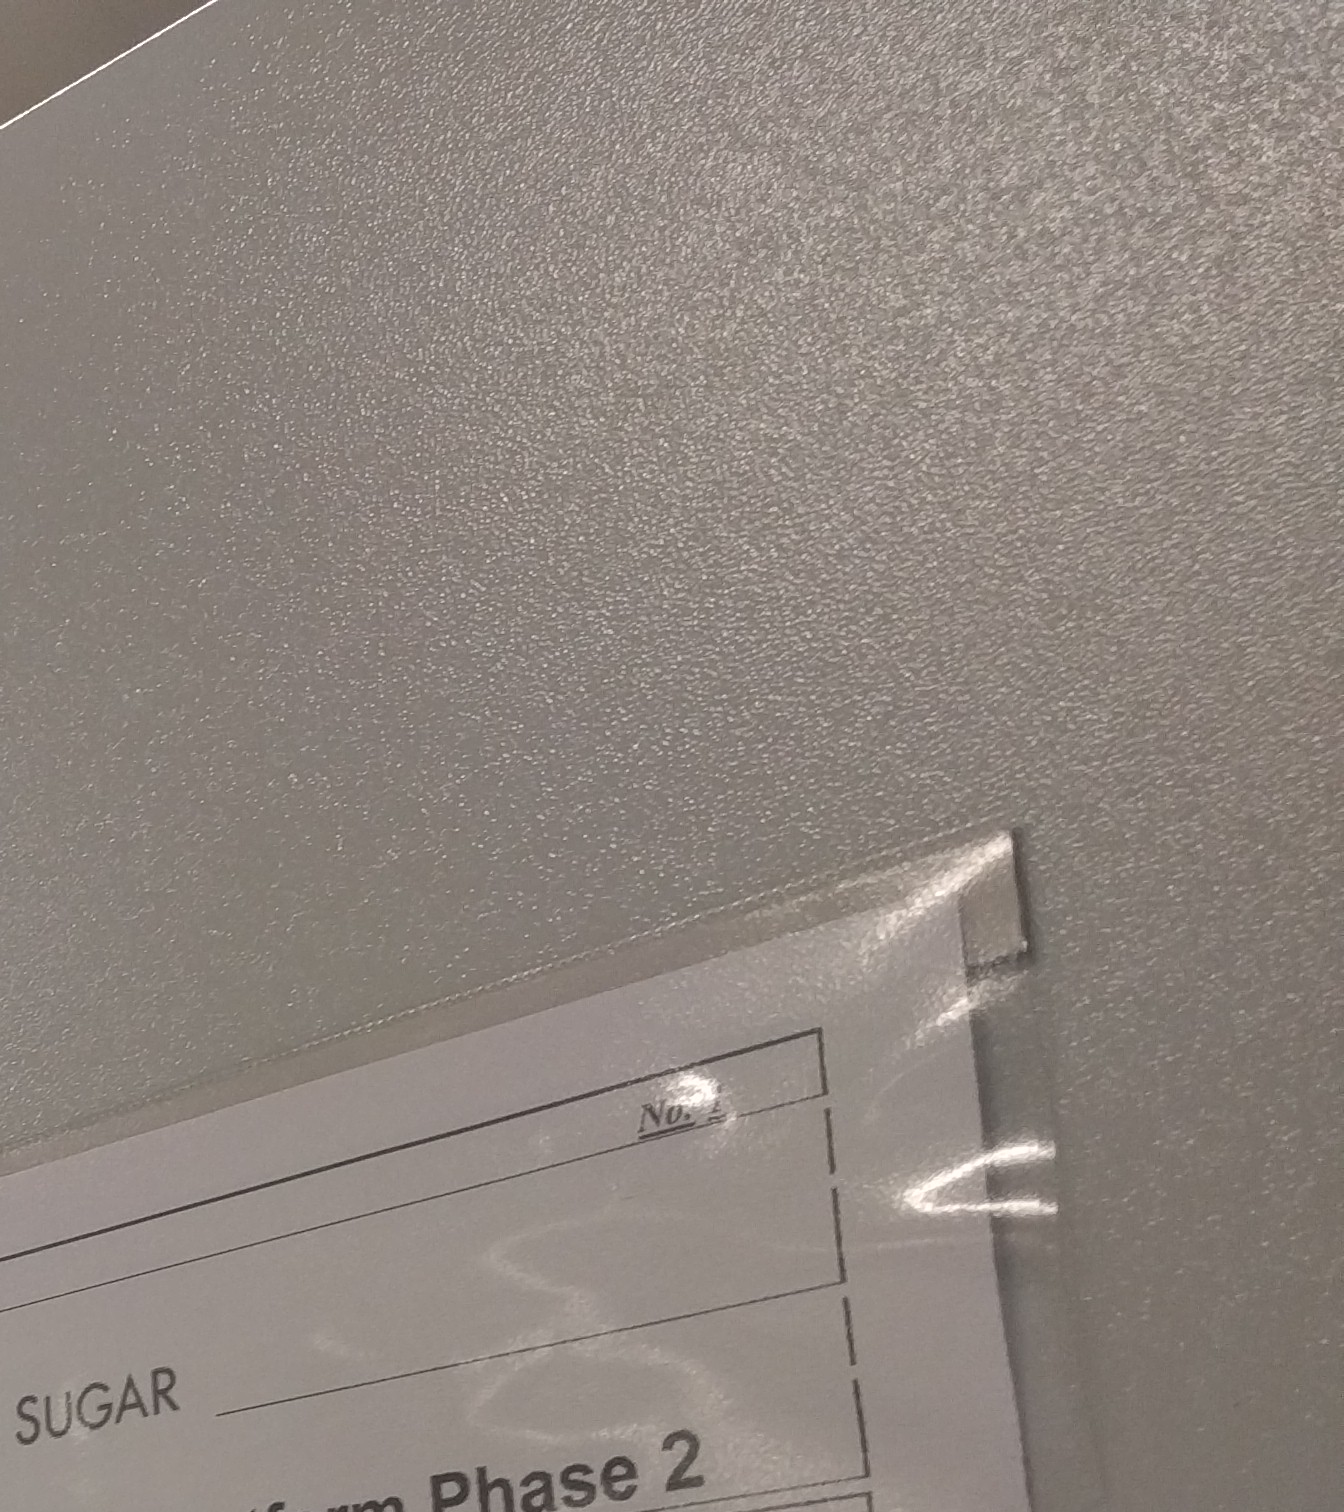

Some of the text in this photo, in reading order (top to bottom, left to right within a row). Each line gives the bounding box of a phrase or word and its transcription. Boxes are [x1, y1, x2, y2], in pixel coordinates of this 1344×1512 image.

[637, 1100, 694, 1134] No.
[15, 1366, 180, 1446] SUGAR
[661, 1429, 706, 1491] 2
